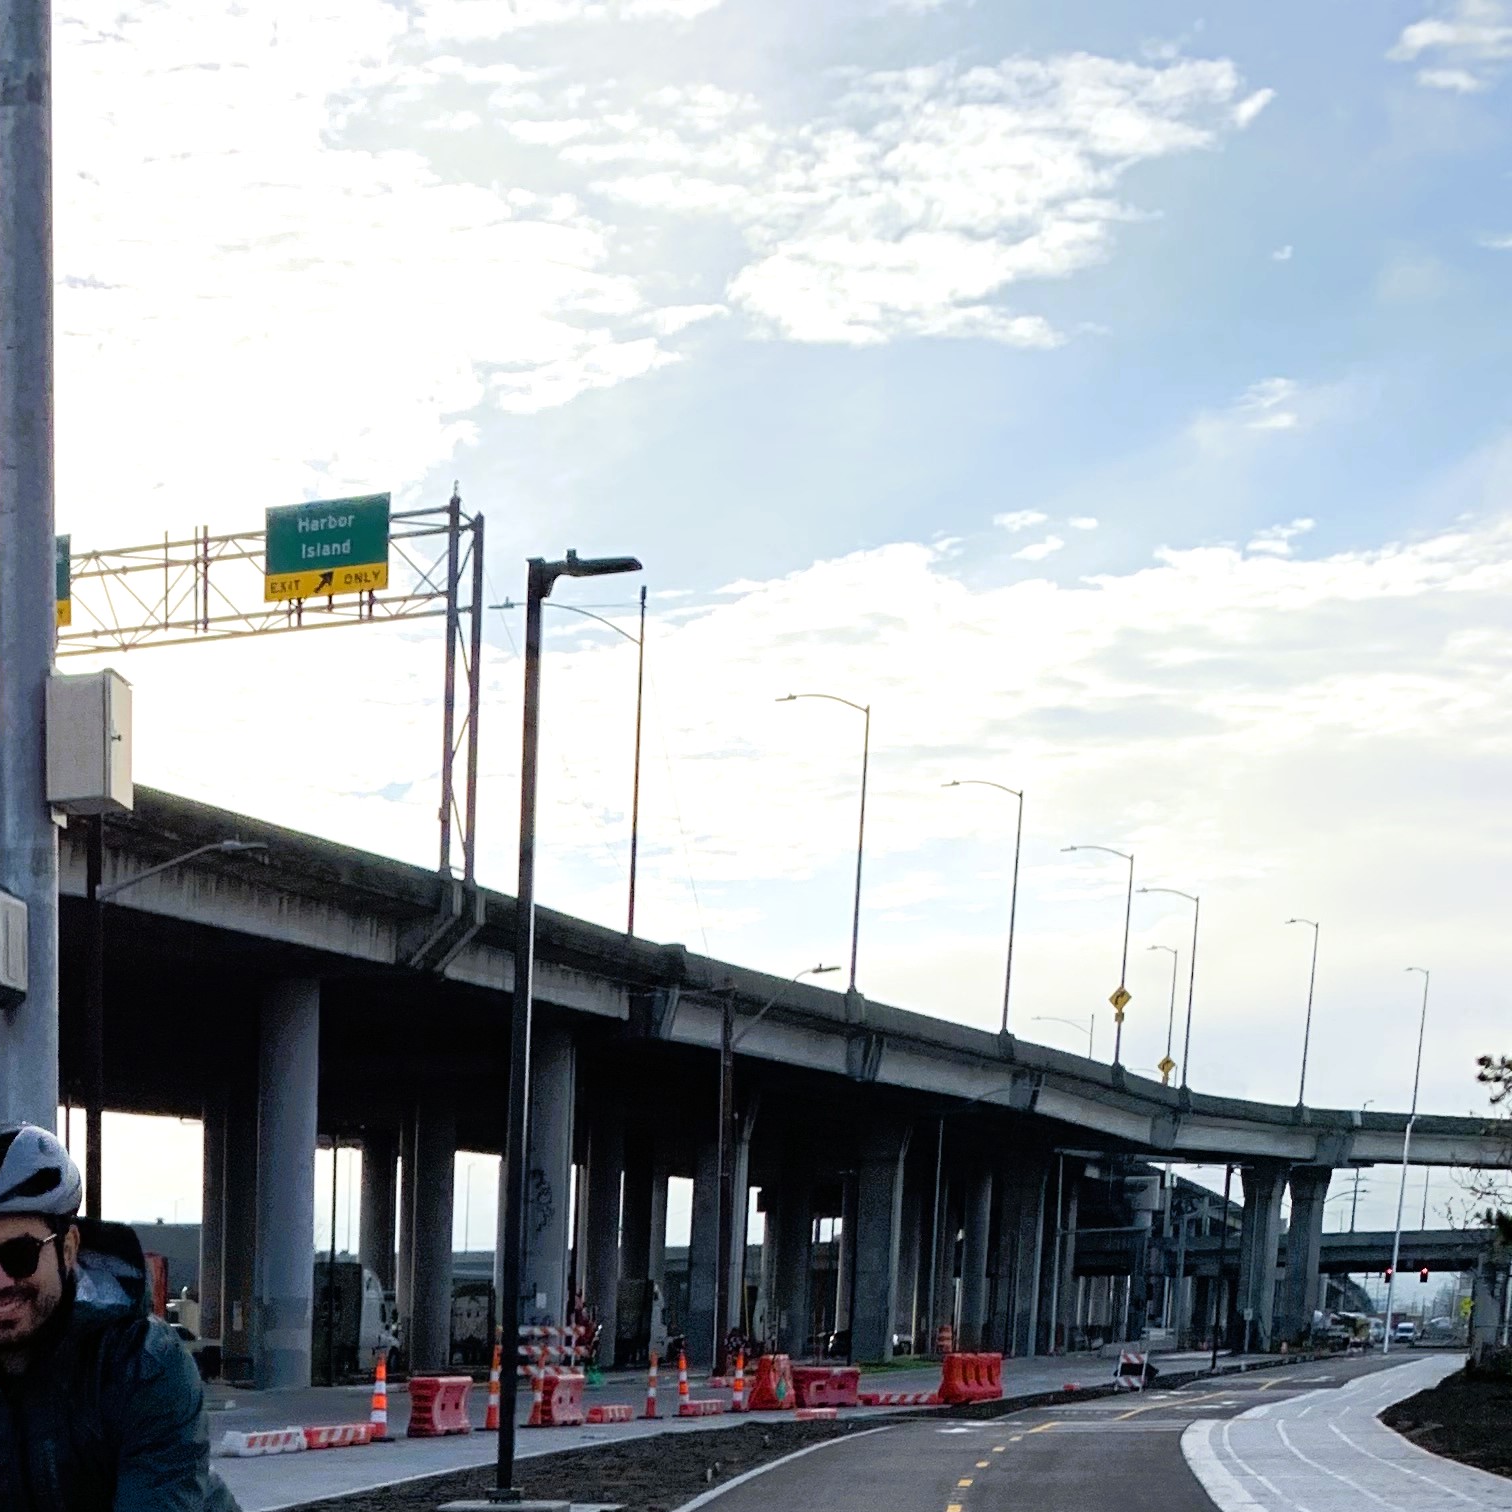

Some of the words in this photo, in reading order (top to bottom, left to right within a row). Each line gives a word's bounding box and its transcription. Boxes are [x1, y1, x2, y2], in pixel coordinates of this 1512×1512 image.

[297, 515, 355, 533] Harbor
[301, 539, 351, 559] Island
[270, 579, 300, 594] EXIT
[344, 570, 381, 585] ONLY
